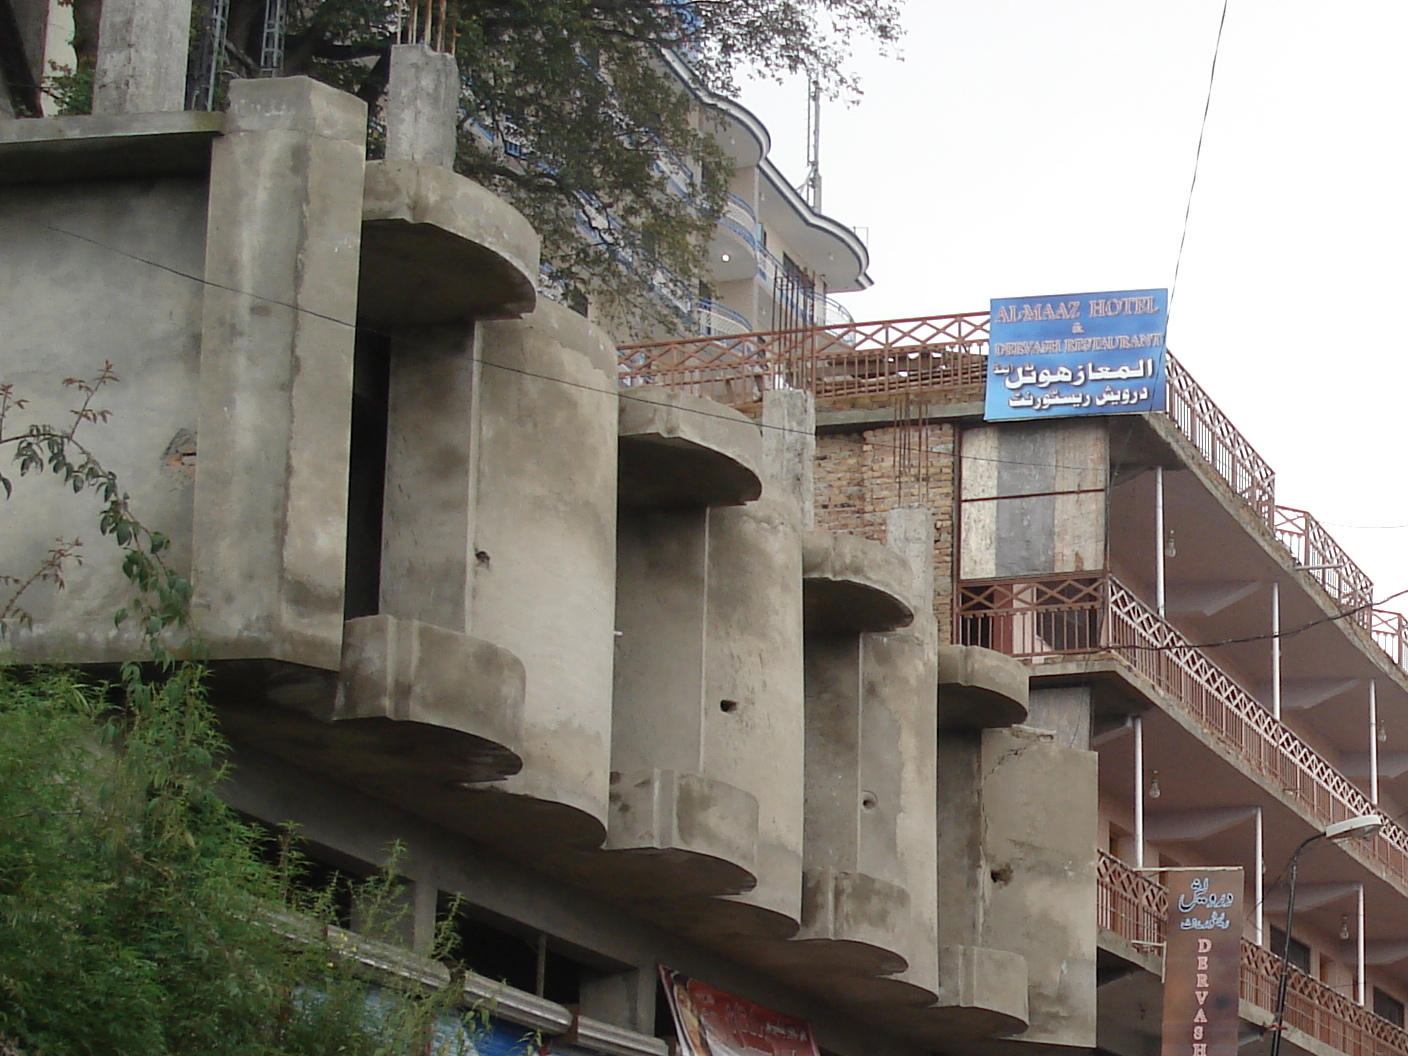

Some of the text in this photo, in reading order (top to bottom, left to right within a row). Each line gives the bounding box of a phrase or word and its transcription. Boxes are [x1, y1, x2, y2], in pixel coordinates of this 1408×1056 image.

[1089, 296, 1160, 318] HOTEL
[1064, 332, 1164, 353] RESTAURANT
[1193, 939, 1211, 1056] DERVASH
